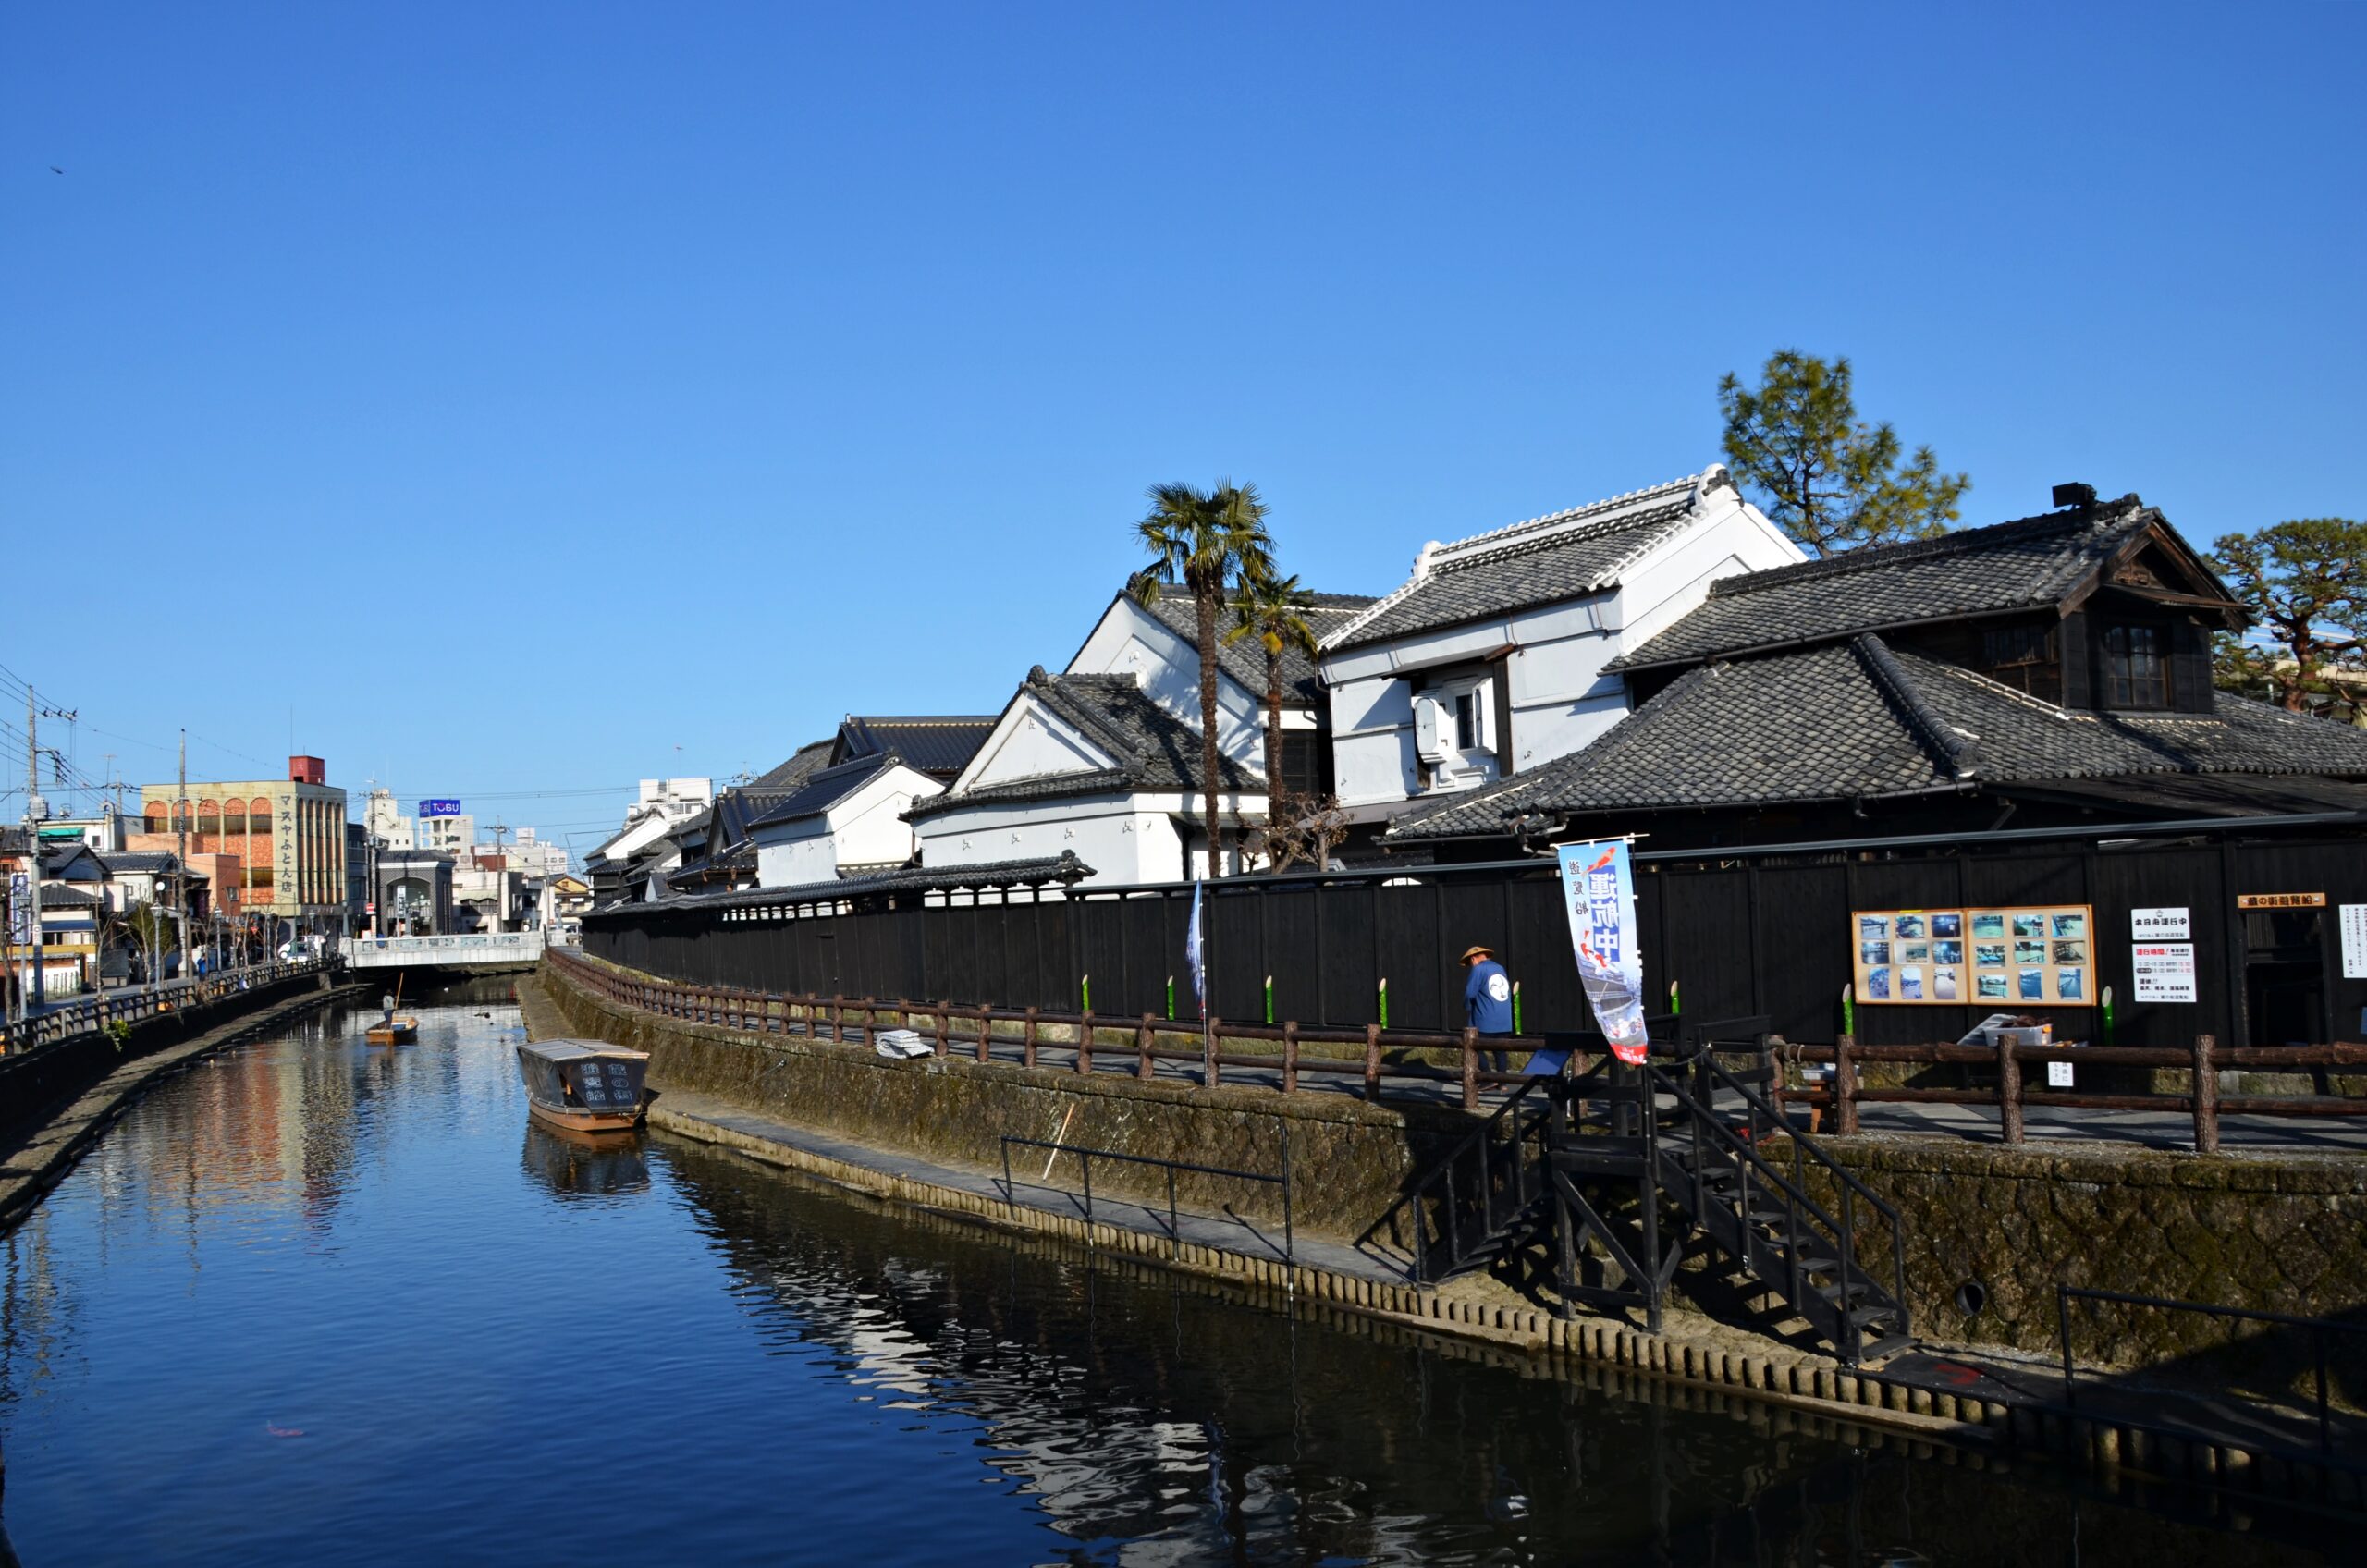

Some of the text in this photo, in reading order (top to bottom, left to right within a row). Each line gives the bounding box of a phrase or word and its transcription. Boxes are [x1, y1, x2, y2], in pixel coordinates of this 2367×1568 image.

[432, 803, 460, 812] TOBU
[280, 795, 293, 893] マスヤふとん店
[2248, 895, 2312, 906] 蔵の街遊覧船
